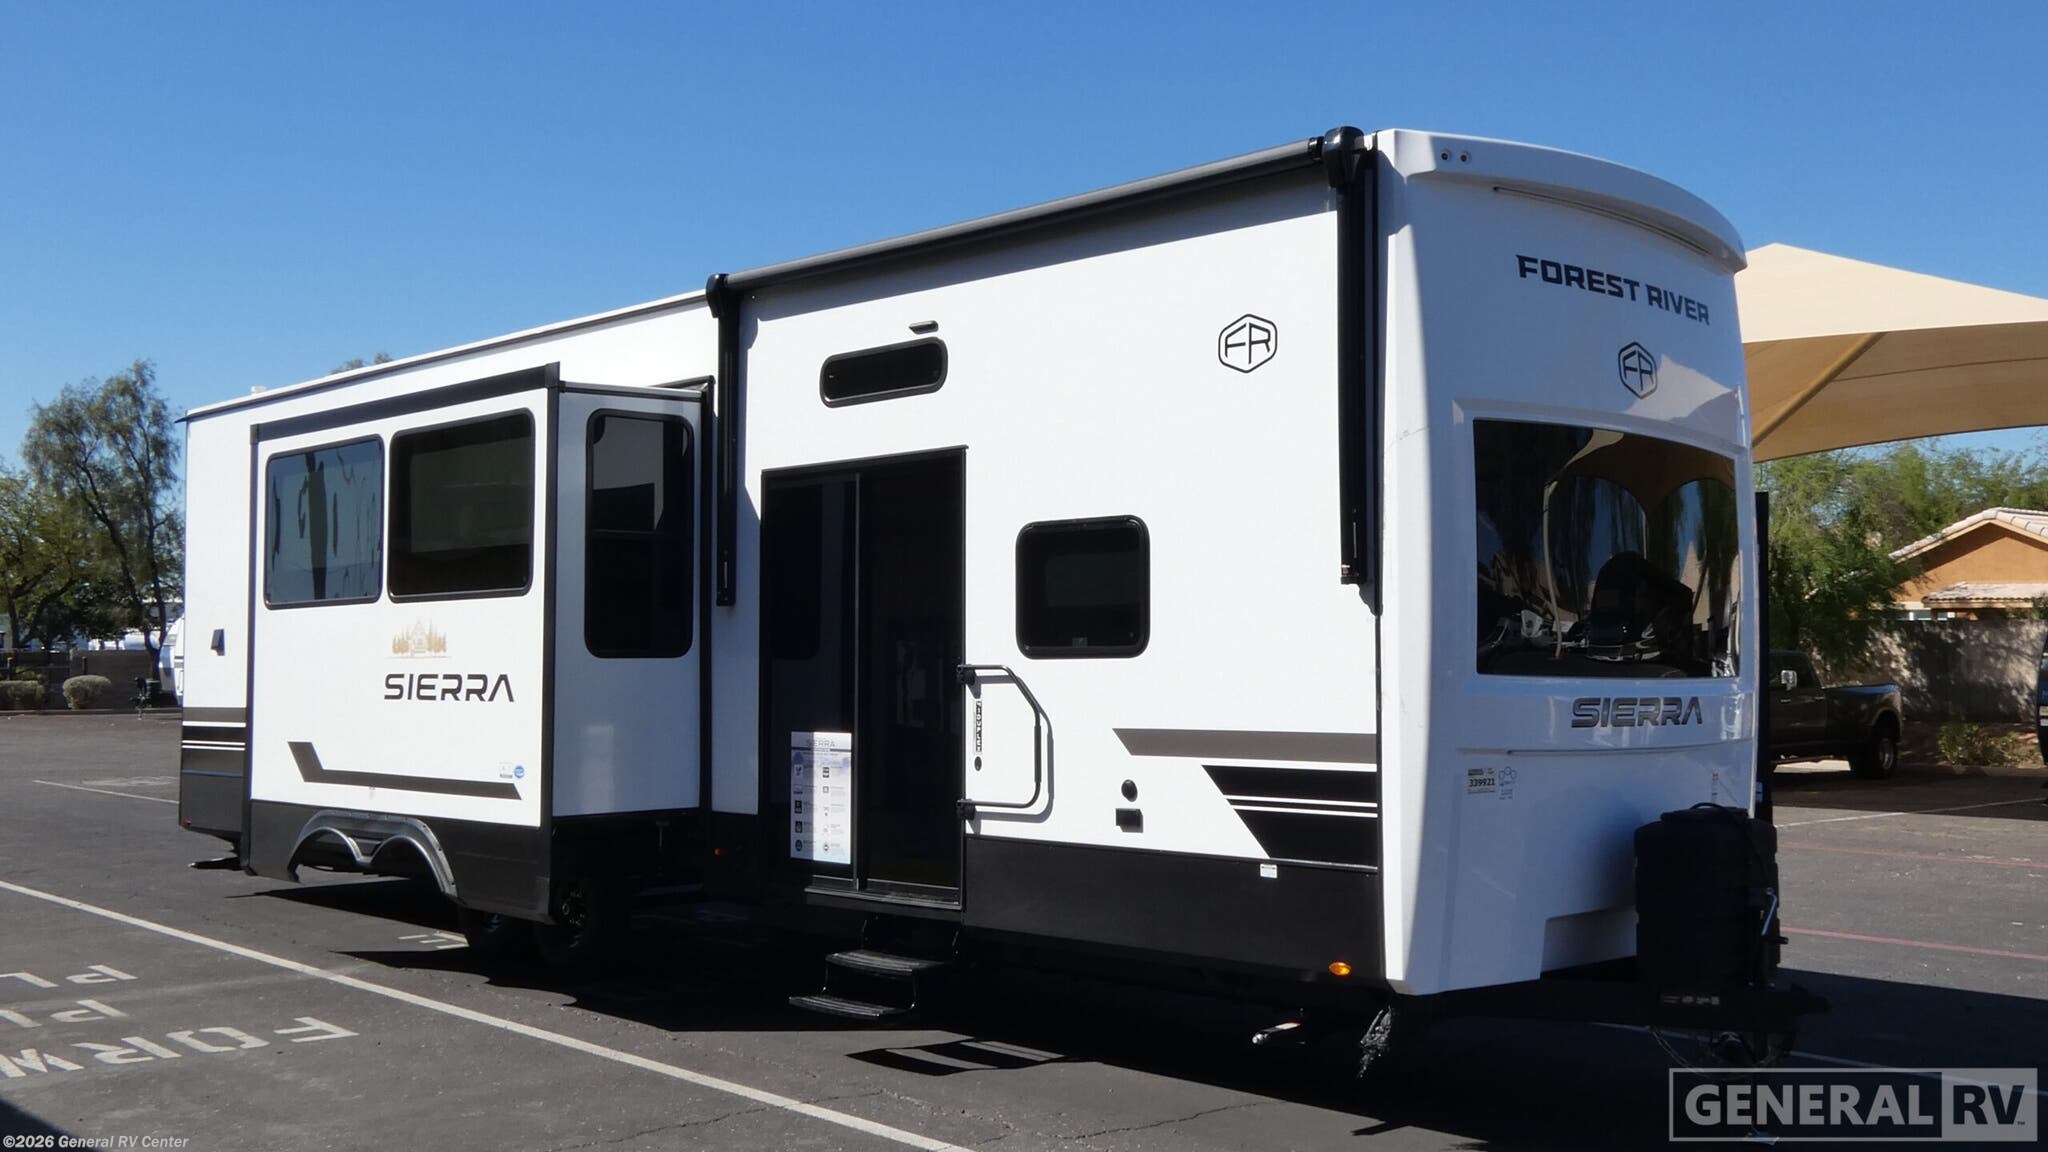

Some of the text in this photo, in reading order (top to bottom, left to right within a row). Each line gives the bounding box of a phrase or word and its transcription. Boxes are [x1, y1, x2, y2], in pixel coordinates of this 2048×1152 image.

[1515, 254, 1711, 326] FOREST RIVER
[383, 673, 515, 702] SIERRA
[1571, 696, 1703, 728] SIERRA
